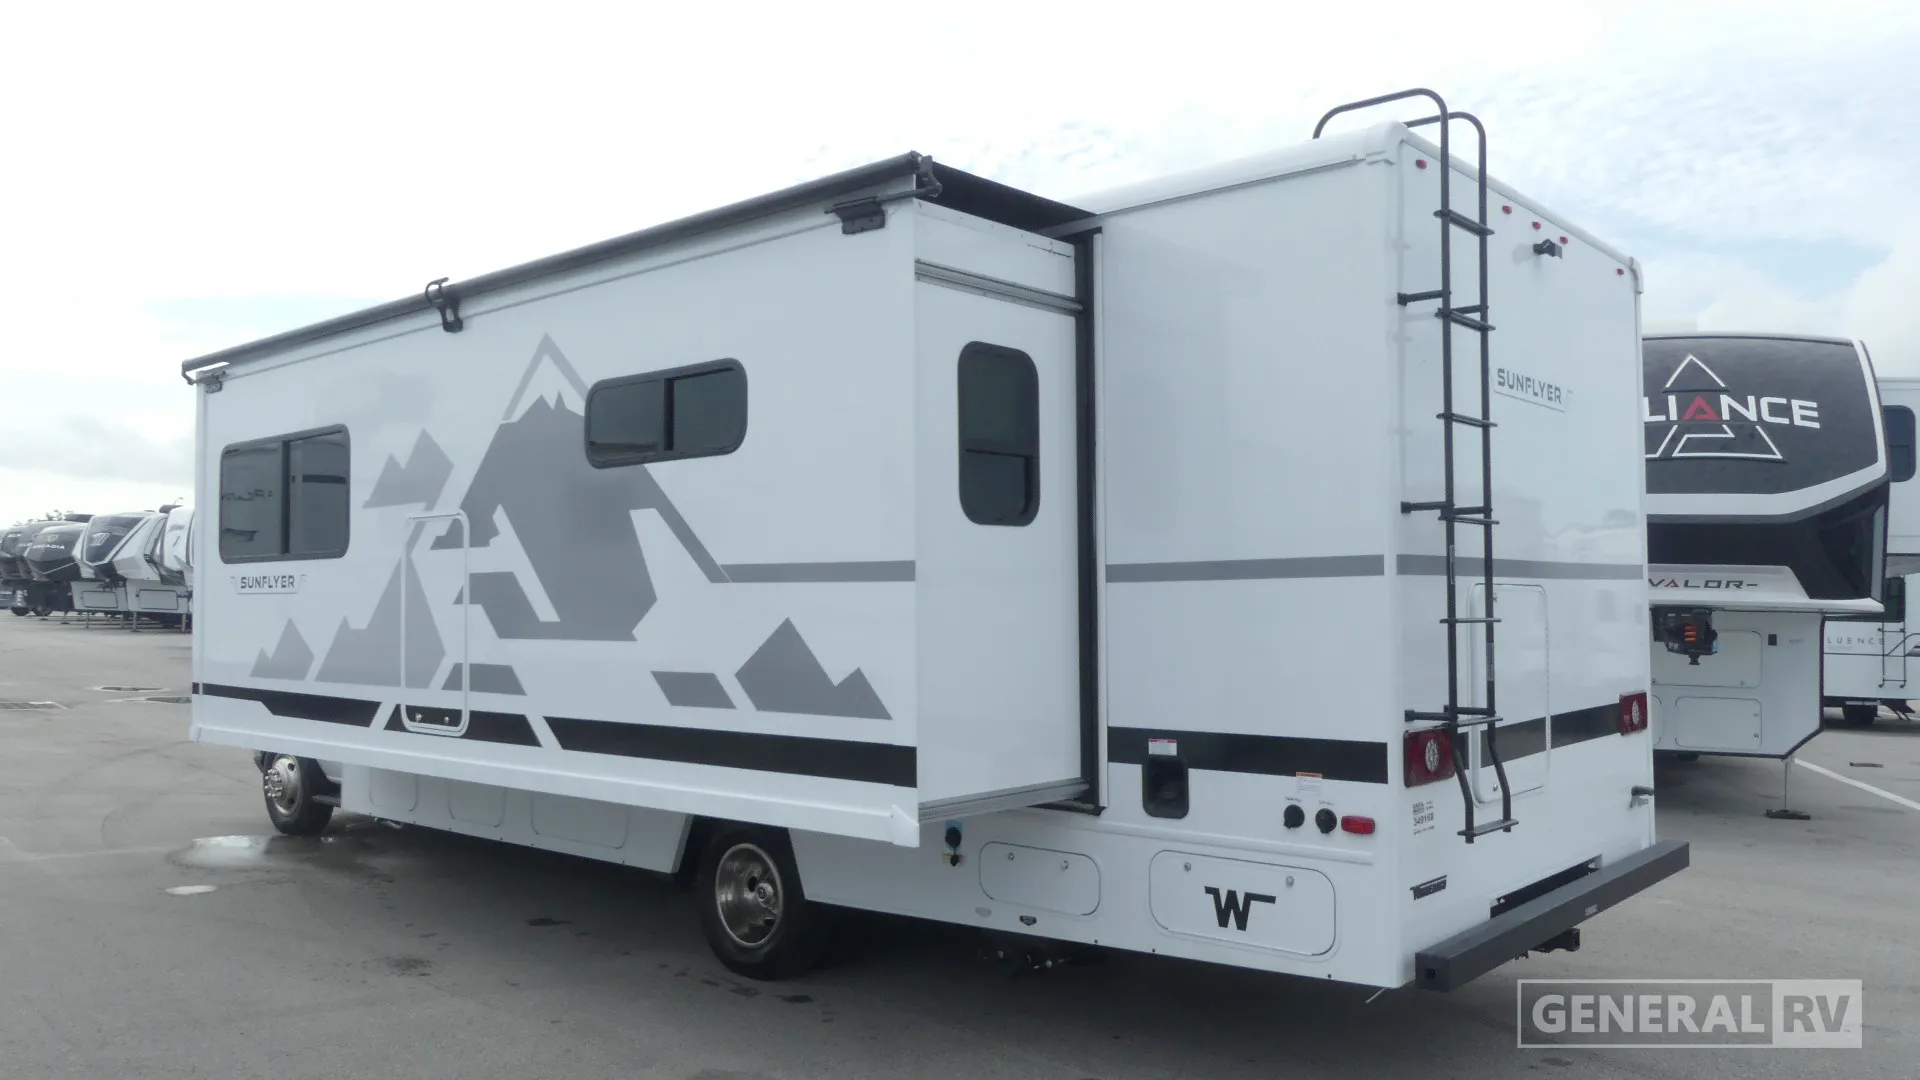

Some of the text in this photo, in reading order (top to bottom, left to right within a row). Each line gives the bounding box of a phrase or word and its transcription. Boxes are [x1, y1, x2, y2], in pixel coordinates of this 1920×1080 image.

[1497, 367, 1563, 404] SUNFLYER
[240, 575, 295, 589] SUNFLYER
[1204, 886, 1276, 931] W
